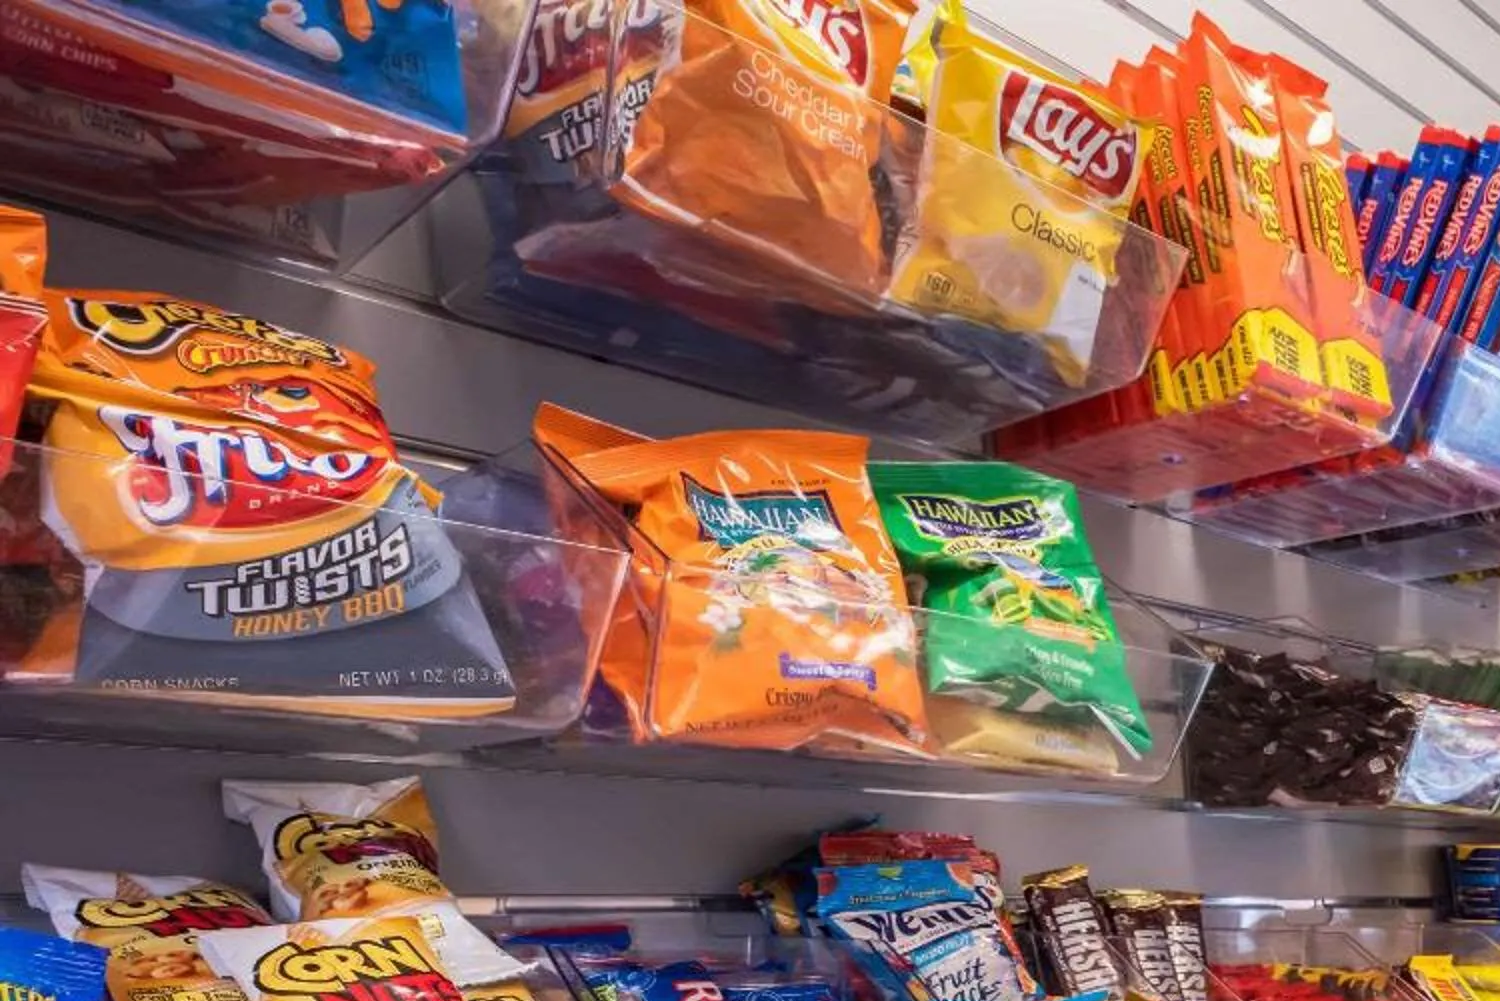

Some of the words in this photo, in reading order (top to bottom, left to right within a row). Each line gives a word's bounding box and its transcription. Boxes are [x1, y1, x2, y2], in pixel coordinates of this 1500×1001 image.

[733, 68, 796, 122] Sour
[750, 50, 849, 125] Cheddar
[1007, 80, 1133, 181] Lay's
[1010, 203, 1097, 262] Classic
[99, 404, 373, 526] Frito
[912, 498, 1034, 529] HAWAIIAN
[186, 523, 413, 617] TWISTS
[237, 519, 377, 584] FLAVOR
[233, 605, 331, 638] HONEY
[342, 582, 406, 622] BBQ
[338, 671, 373, 688] NET
[375, 670, 401, 687] WT
[254, 935, 433, 996] CORN
[1051, 899, 1121, 991] HERSH
[925, 957, 987, 995] Fruit
